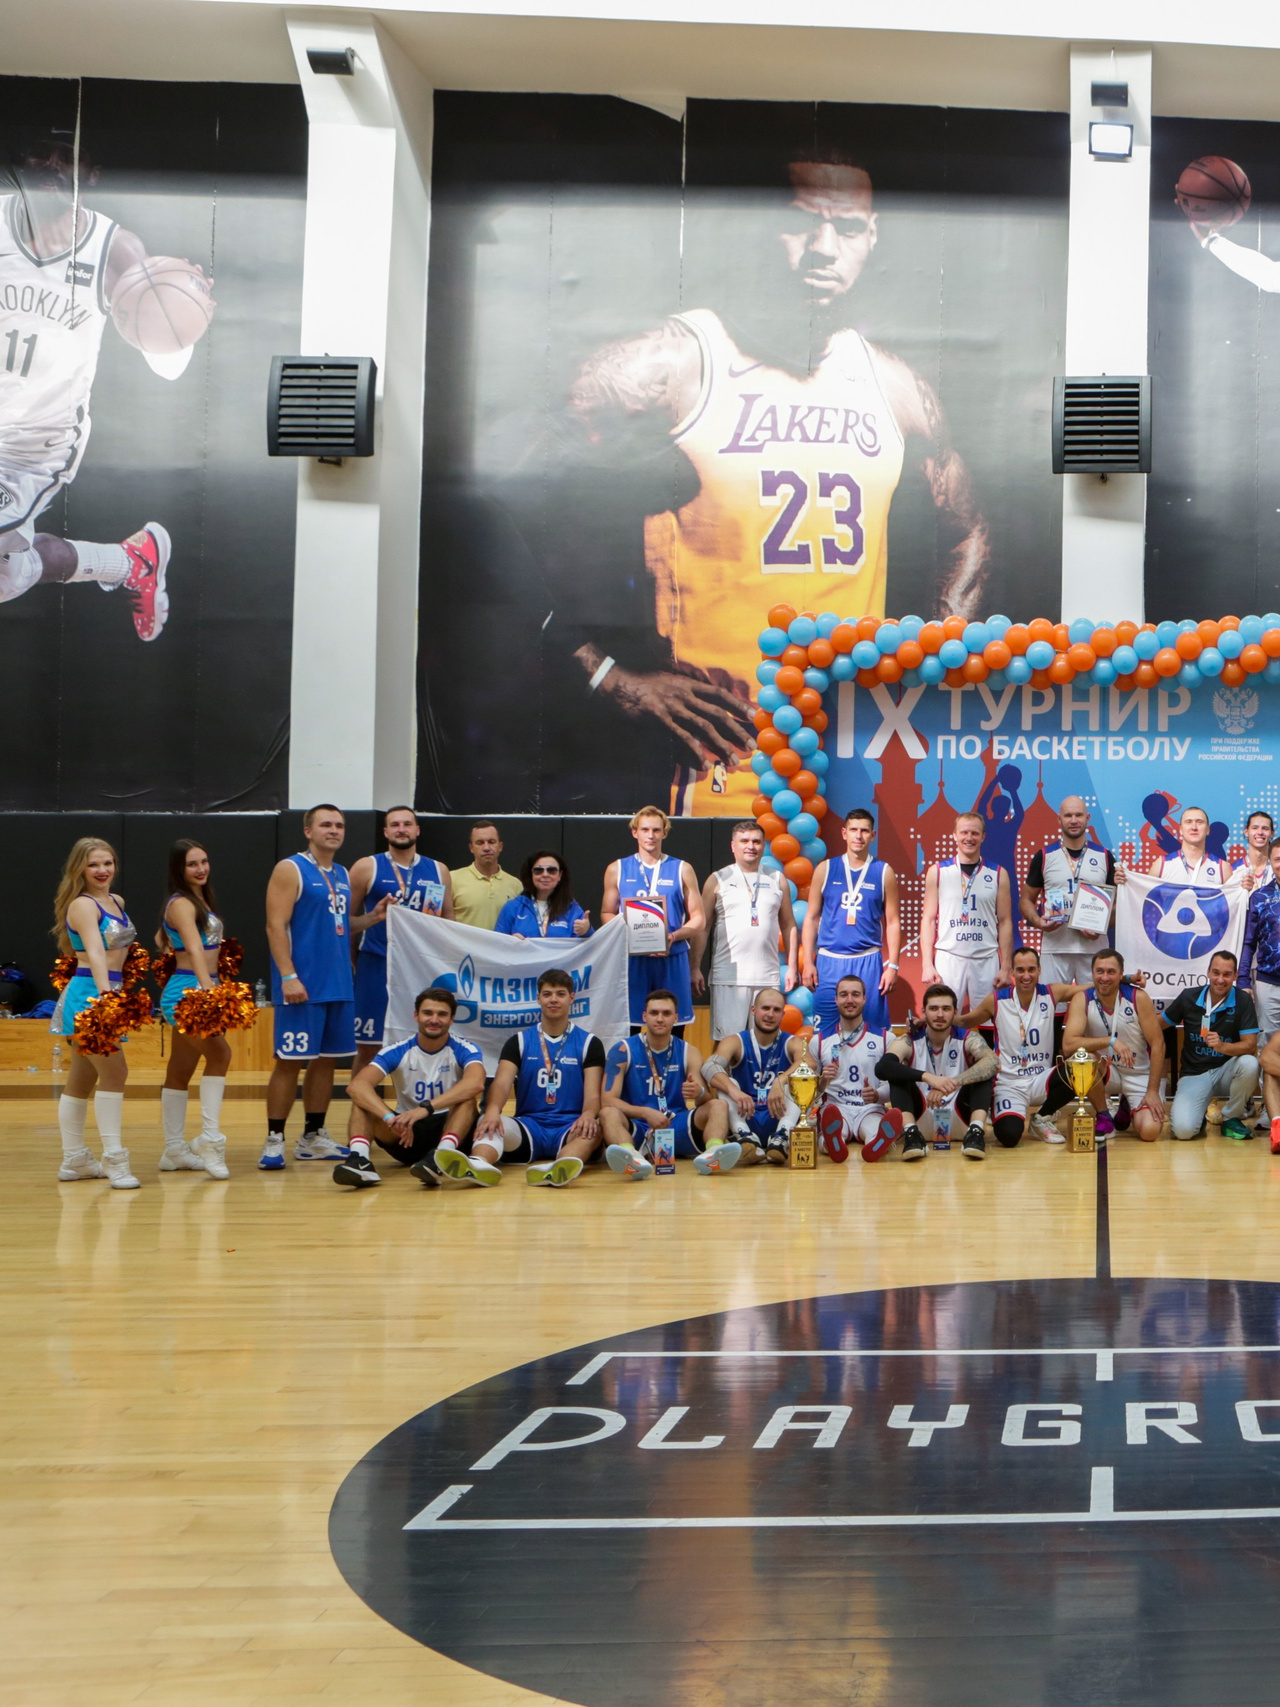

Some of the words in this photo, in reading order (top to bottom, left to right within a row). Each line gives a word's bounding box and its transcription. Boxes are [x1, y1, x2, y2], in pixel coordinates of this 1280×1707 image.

[0, 284, 92, 331] OOKLYN
[5, 328, 38, 378] 11
[718, 393, 881, 457] LAKERS
[760, 469, 868, 575] 23
[937, 681, 1192, 732] ТУРНИР
[836, 681, 928, 759] IX
[936, 734, 982, 760] ПО
[992, 734, 1193, 761] БАСКЕТБОЛУ
[1210, 737, 1223, 745] ПРИ
[1223, 737, 1261, 745] ПОДДЕРЖКЕ
[1198, 753, 1237, 761] РОССИЙСКОЙ
[1237, 754, 1273, 762] ФЕДЕРАЦИИ
[841, 893, 863, 910] 92
[1080, 903, 1105, 913] ДИПЛОМ
[633, 922, 660, 931] ДИПЛОМ
[955, 932, 983, 942] САРОВ
[479, 965, 592, 1004] ГАЗПМ
[1142, 971, 1208, 987] РОСАТО
[354, 1017, 375, 1038] 24
[282, 1032, 309, 1053] 33
[537, 1068, 562, 1088] 69
[849, 1065, 860, 1082] 8
[415, 1081, 444, 1101] 911
[996, 1099, 1012, 1114] 10
